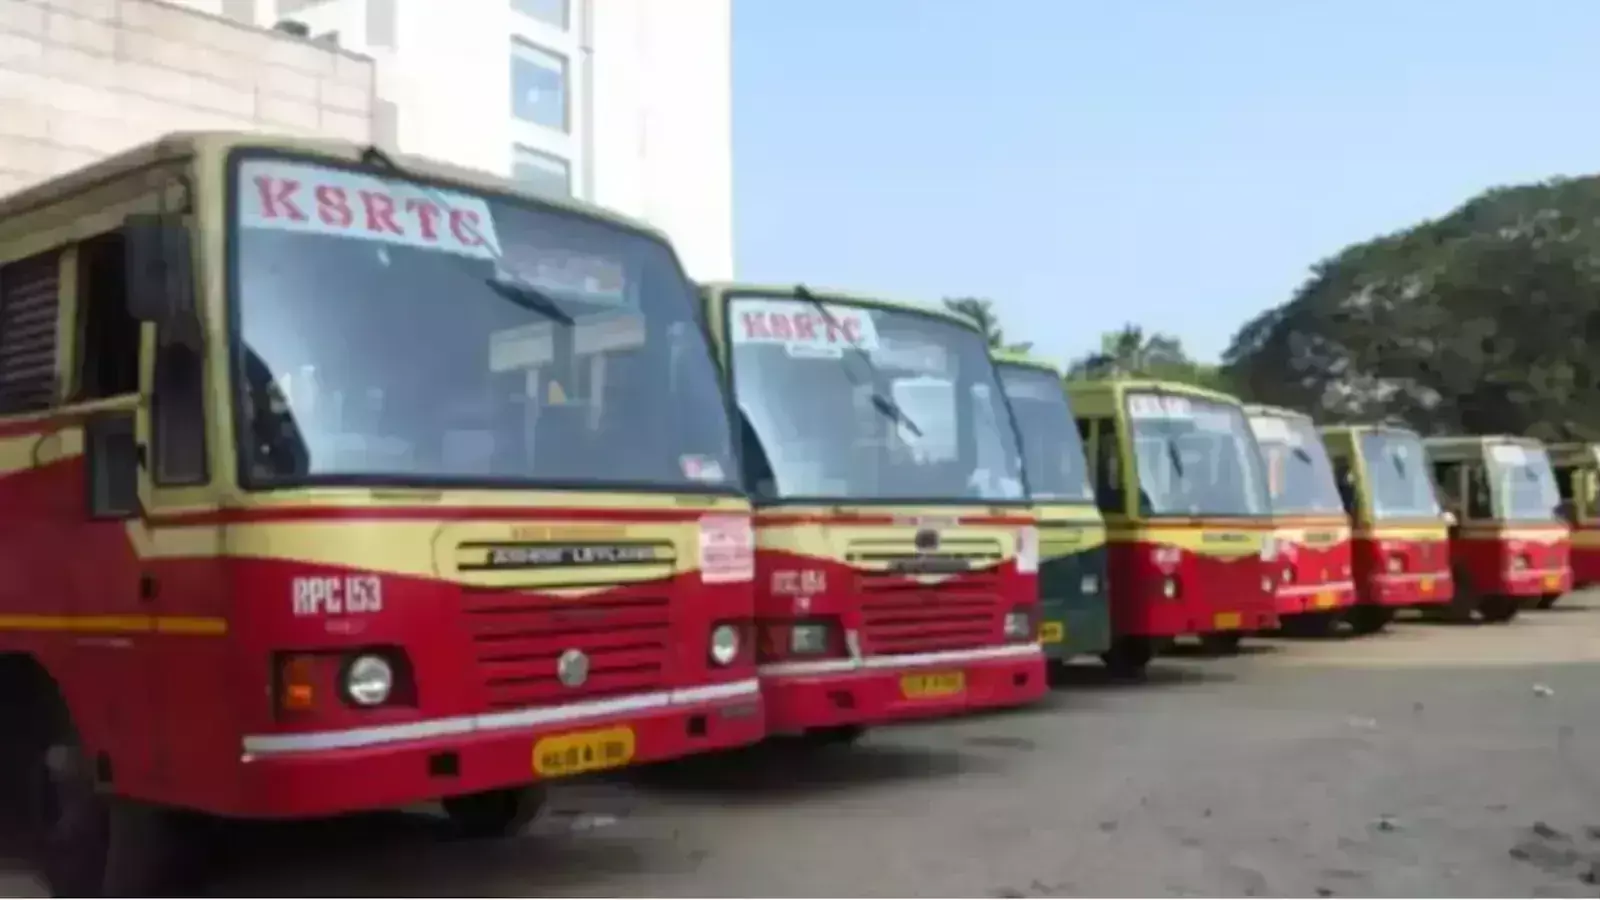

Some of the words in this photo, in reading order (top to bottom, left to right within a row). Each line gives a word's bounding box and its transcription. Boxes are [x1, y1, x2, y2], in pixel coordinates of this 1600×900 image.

[253, 174, 487, 248] KSRTC
[740, 311, 864, 344] KSRTC
[292, 576, 342, 615] RPC
